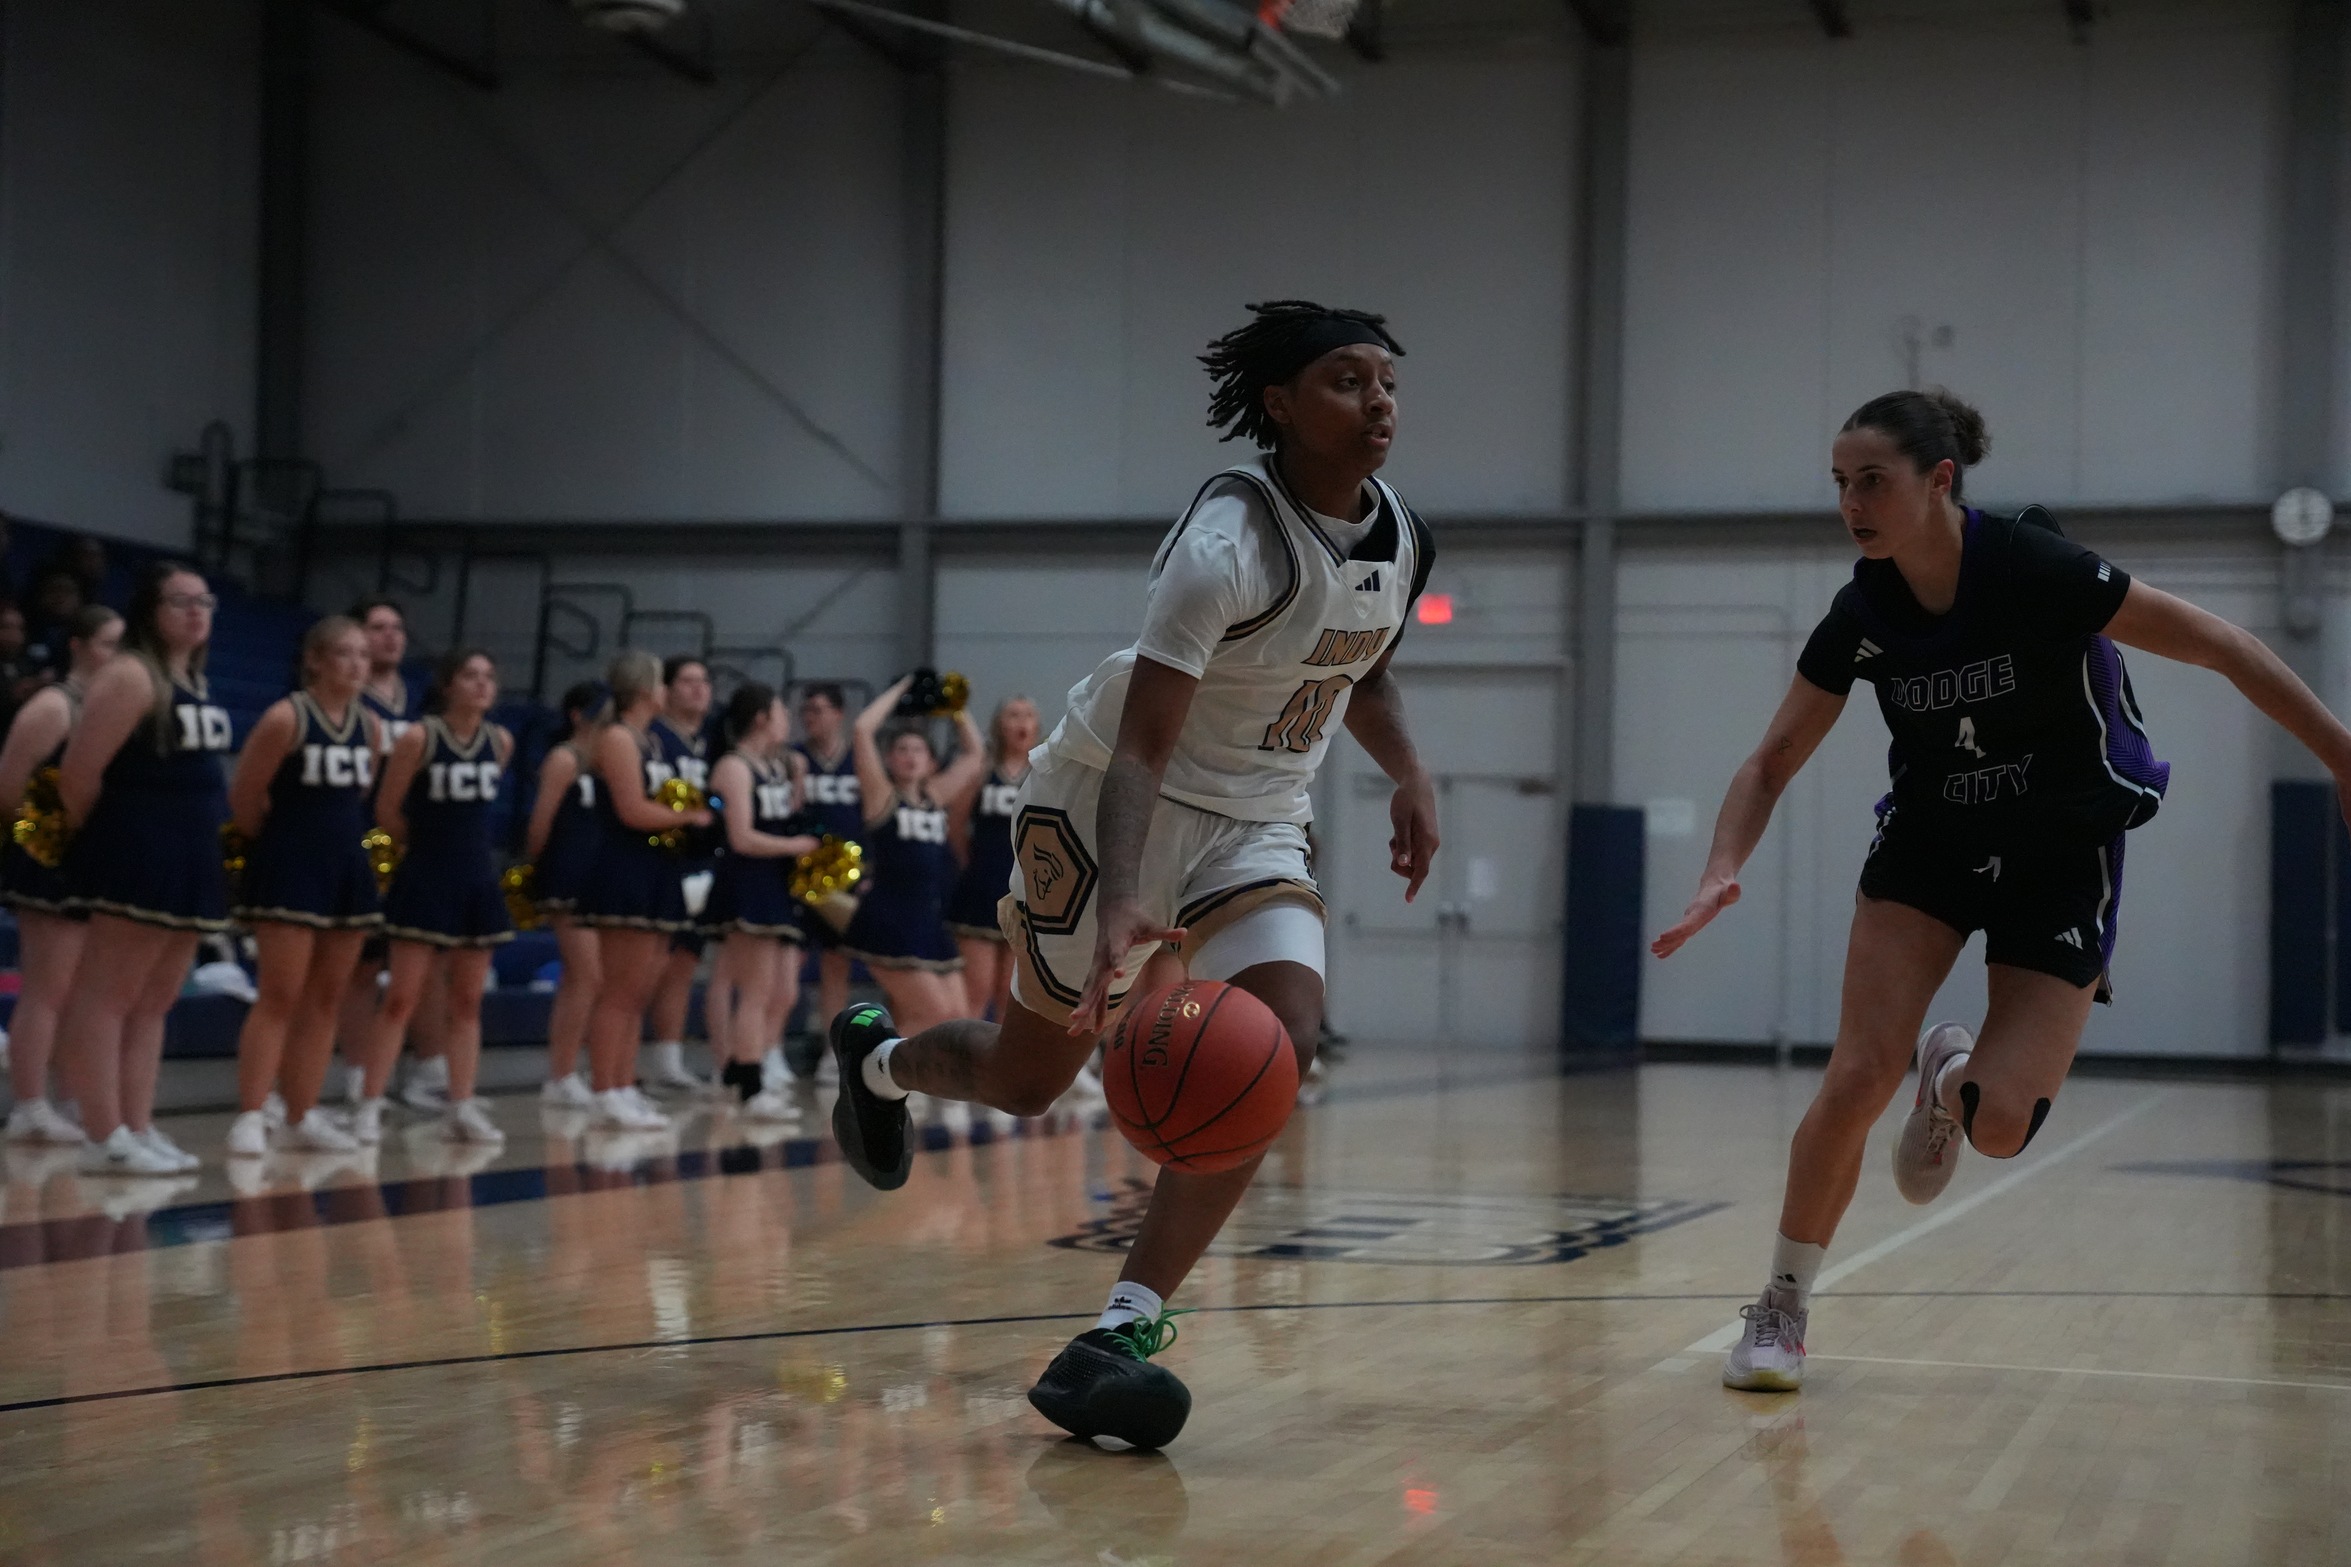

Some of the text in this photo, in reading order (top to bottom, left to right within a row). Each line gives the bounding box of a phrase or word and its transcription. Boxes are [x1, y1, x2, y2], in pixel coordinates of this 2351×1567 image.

[1300, 626, 1391, 667] INDY
[1891, 653, 2016, 712] DODGE
[1954, 716, 1987, 759] 4
[427, 760, 500, 802] ICC
[1943, 753, 2033, 805] CITY
